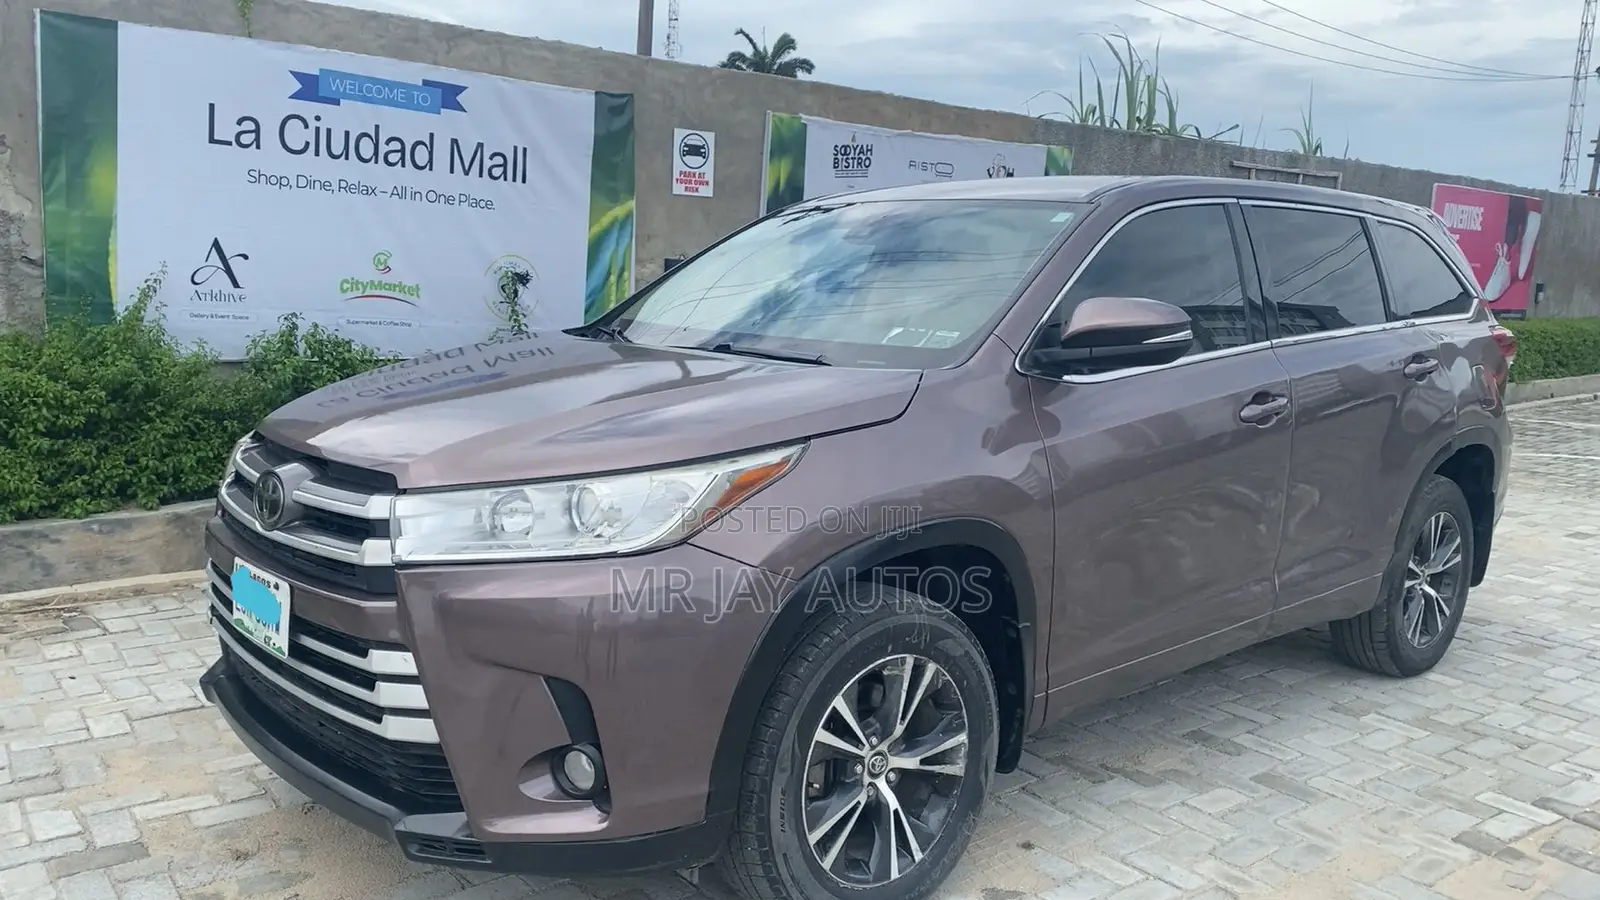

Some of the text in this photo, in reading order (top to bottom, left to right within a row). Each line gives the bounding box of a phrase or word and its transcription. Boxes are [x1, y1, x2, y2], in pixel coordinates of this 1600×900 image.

[329, 76, 431, 106] WELCOME TO
[207, 102, 528, 184] La Ciudad Mall
[833, 143, 873, 157] SOOYAH
[833, 156, 872, 170] BISTRO
[675, 178, 710, 187] YOUR OWN
[679, 170, 706, 180] PARK AT
[247, 168, 292, 190] Shop,
[296, 174, 335, 195] Dine,
[338, 178, 378, 196] Relax
[389, 185, 407, 200] All
[410, 186, 423, 202] in
[425, 189, 456, 206] One
[458, 193, 496, 211] Place.
[1443, 203, 1484, 231] ADVERTISE
[190, 289, 247, 303] Arkhive
[339, 277, 420, 299] CityMarket
